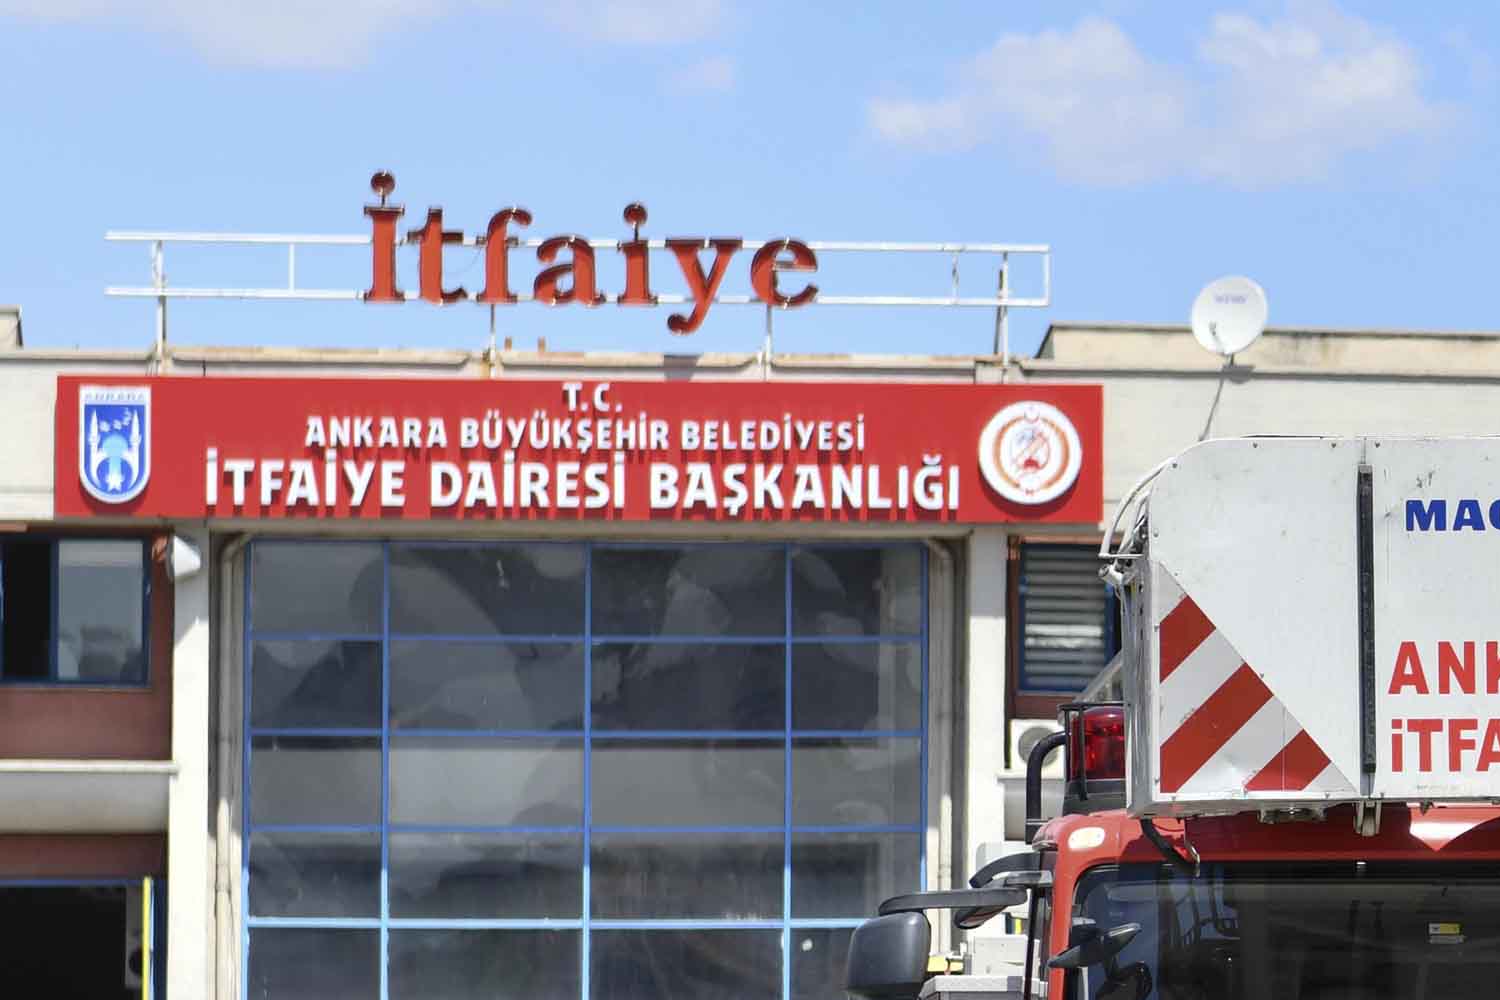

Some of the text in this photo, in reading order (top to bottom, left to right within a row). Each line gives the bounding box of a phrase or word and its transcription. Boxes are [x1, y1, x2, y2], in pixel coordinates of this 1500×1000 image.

[305, 409, 865, 455] ANKARA BÜYÜKŞEHİR BELEDİYESİ
[206, 446, 960, 516] İTFAİYE DAİRESİ BAŞKANLIĞI
